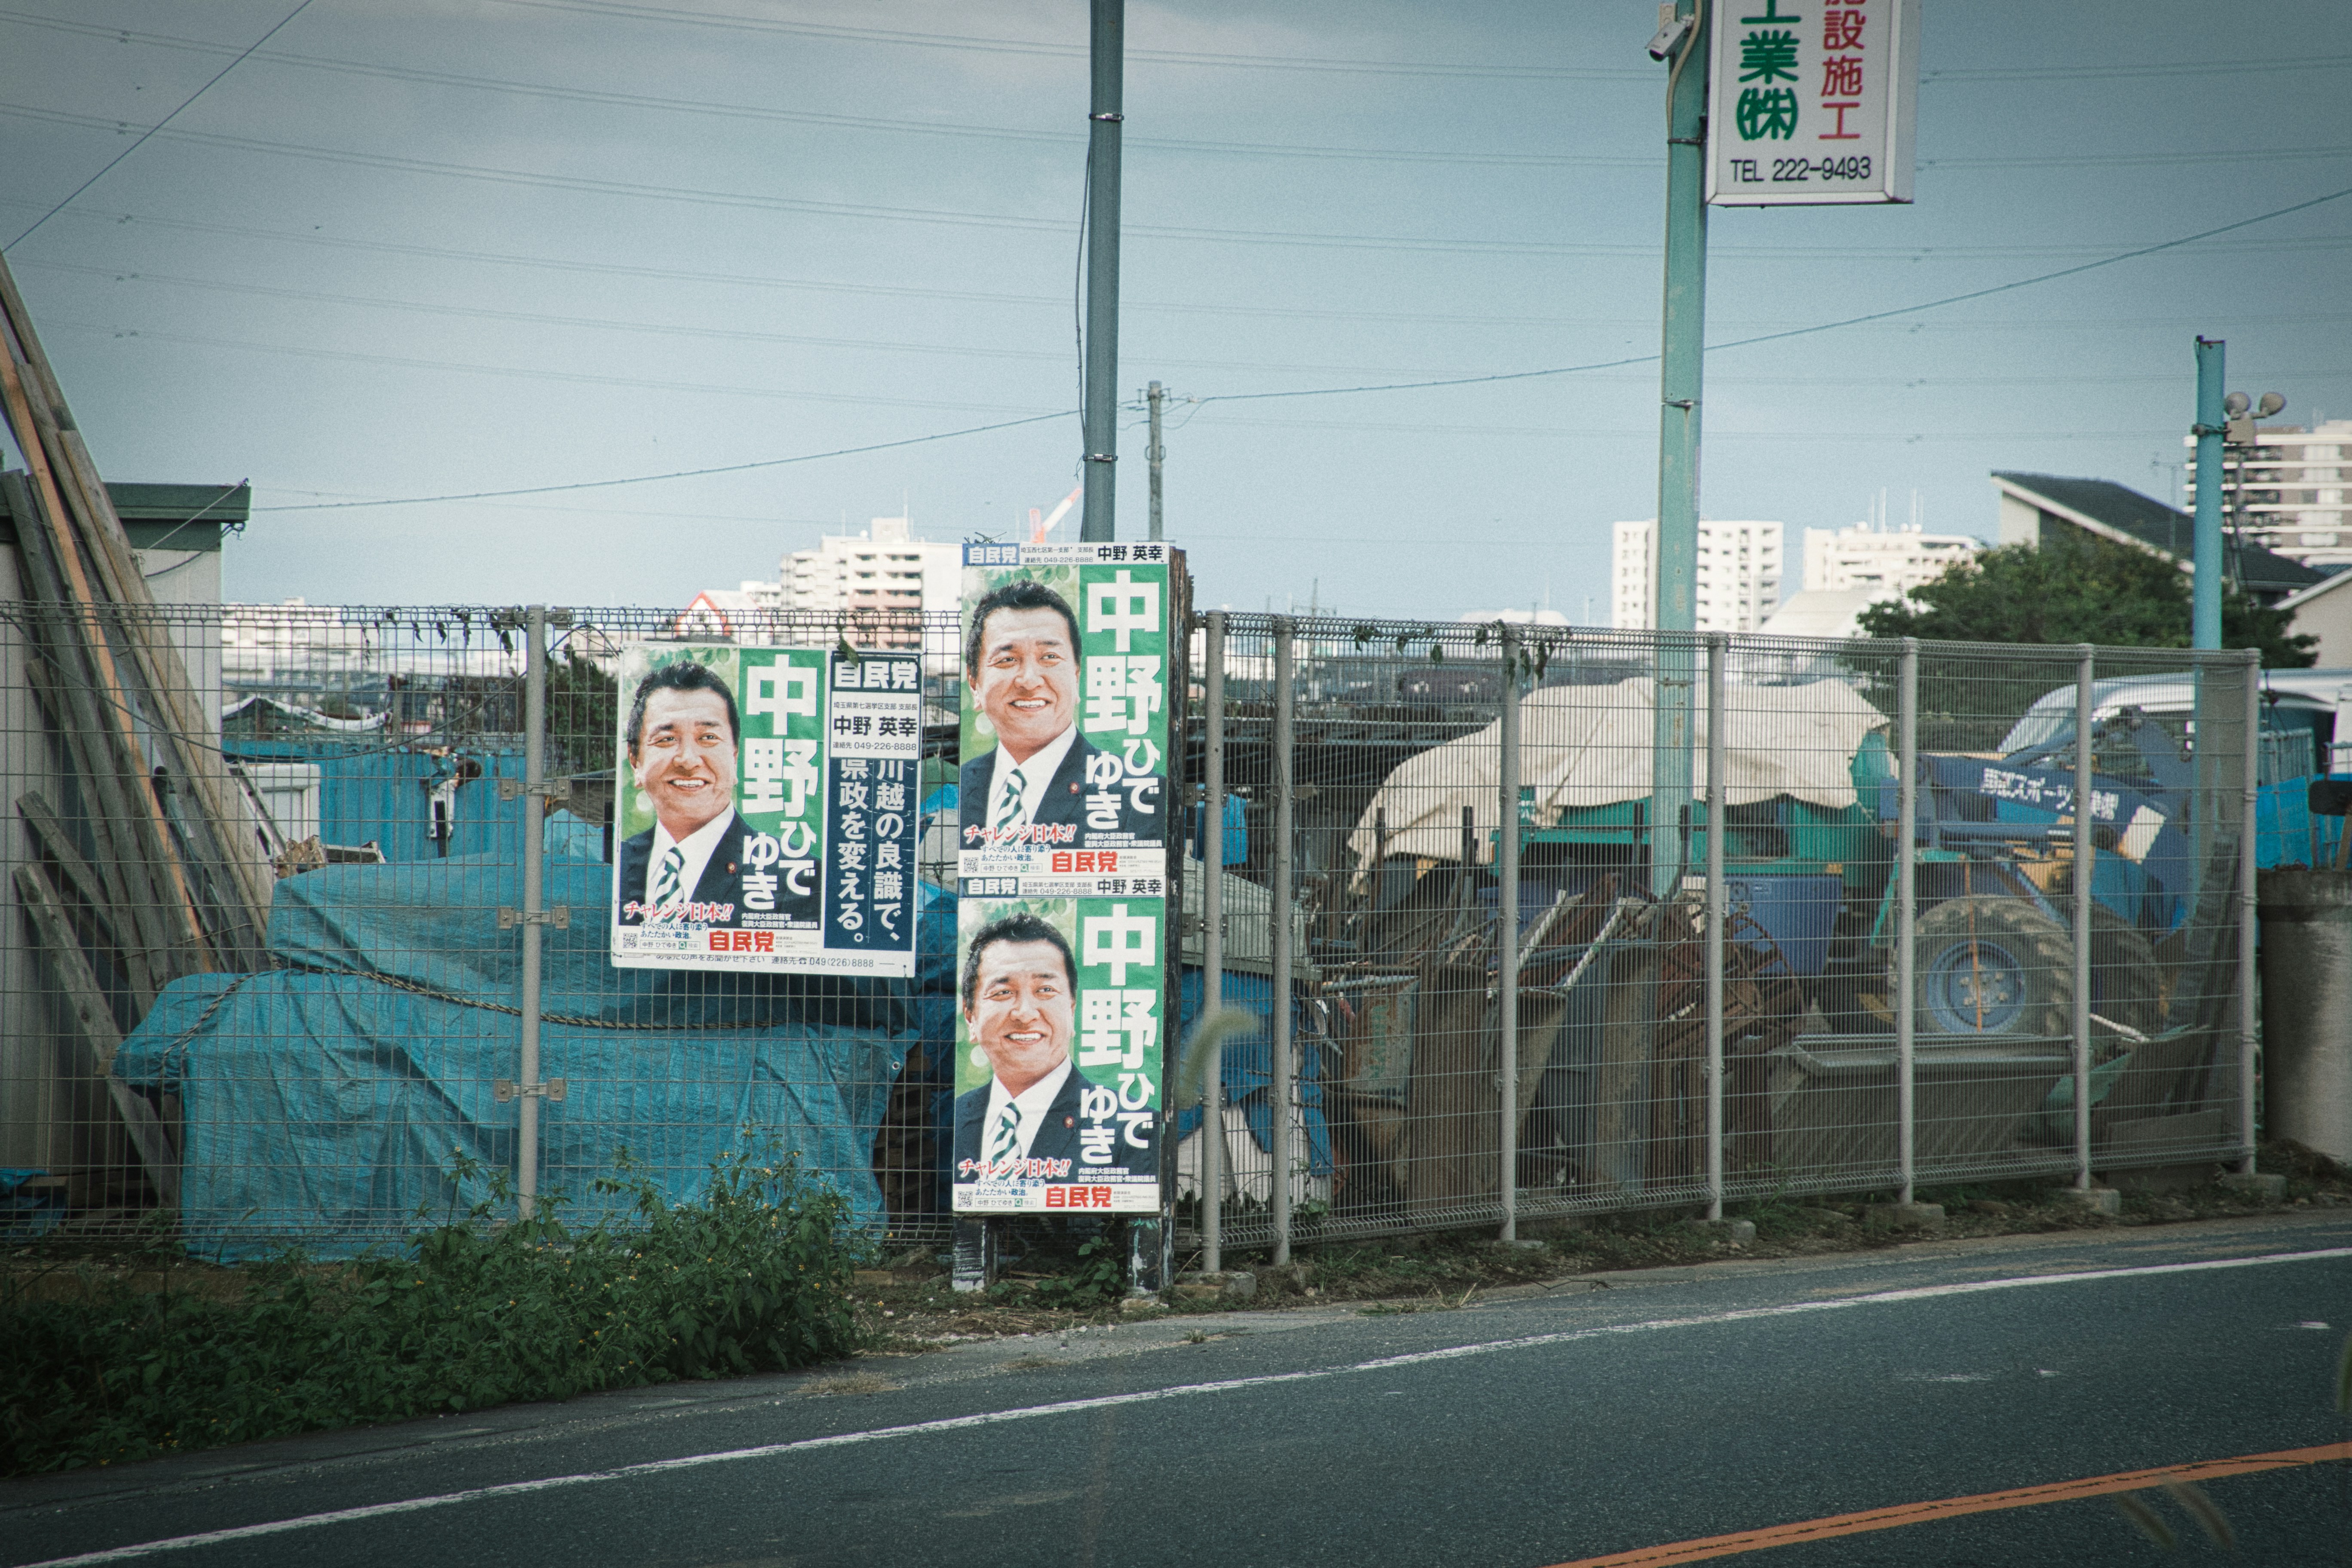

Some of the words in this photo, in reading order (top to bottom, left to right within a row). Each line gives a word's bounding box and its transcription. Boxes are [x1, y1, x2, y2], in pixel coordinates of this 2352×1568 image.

[1819, 0, 1866, 139] 設施工
[1730, 159, 1764, 182] TEL
[1773, 156, 1871, 181] 222-9493
[969, 546, 1017, 564] 自民党
[1098, 545, 1127, 561] 中野
[1133, 545, 1163, 561] 英幸
[1084, 570, 1162, 735] 中野
[835, 660, 917, 689] 自民党
[833, 701, 897, 710] 埼玉県第七選挙区支部
[834, 715, 871, 735] 中野
[879, 717, 917, 737] 英幸
[742, 654, 818, 817] 中野
[854, 742, 917, 750] 049-226-8888
[1052, 851, 1118, 872] 自民党
[968, 878, 1016, 895] 自民党
[1097, 879, 1127, 894] 中野
[1132, 879, 1162, 894] 英幸
[640, 922, 708, 931] すべての人に寄り添う
[640, 931, 693, 939] あたたかい政治。
[709, 930, 775, 952] 自民党
[810, 957, 874, 968] 049(226)8888
[1079, 903, 1157, 1069] 中野
[975, 1188, 1029, 1196] あたたかい政治。
[976, 1179, 1045, 1188] すべての人に寄り添う
[1046, 1186, 1112, 1207] 自民党
